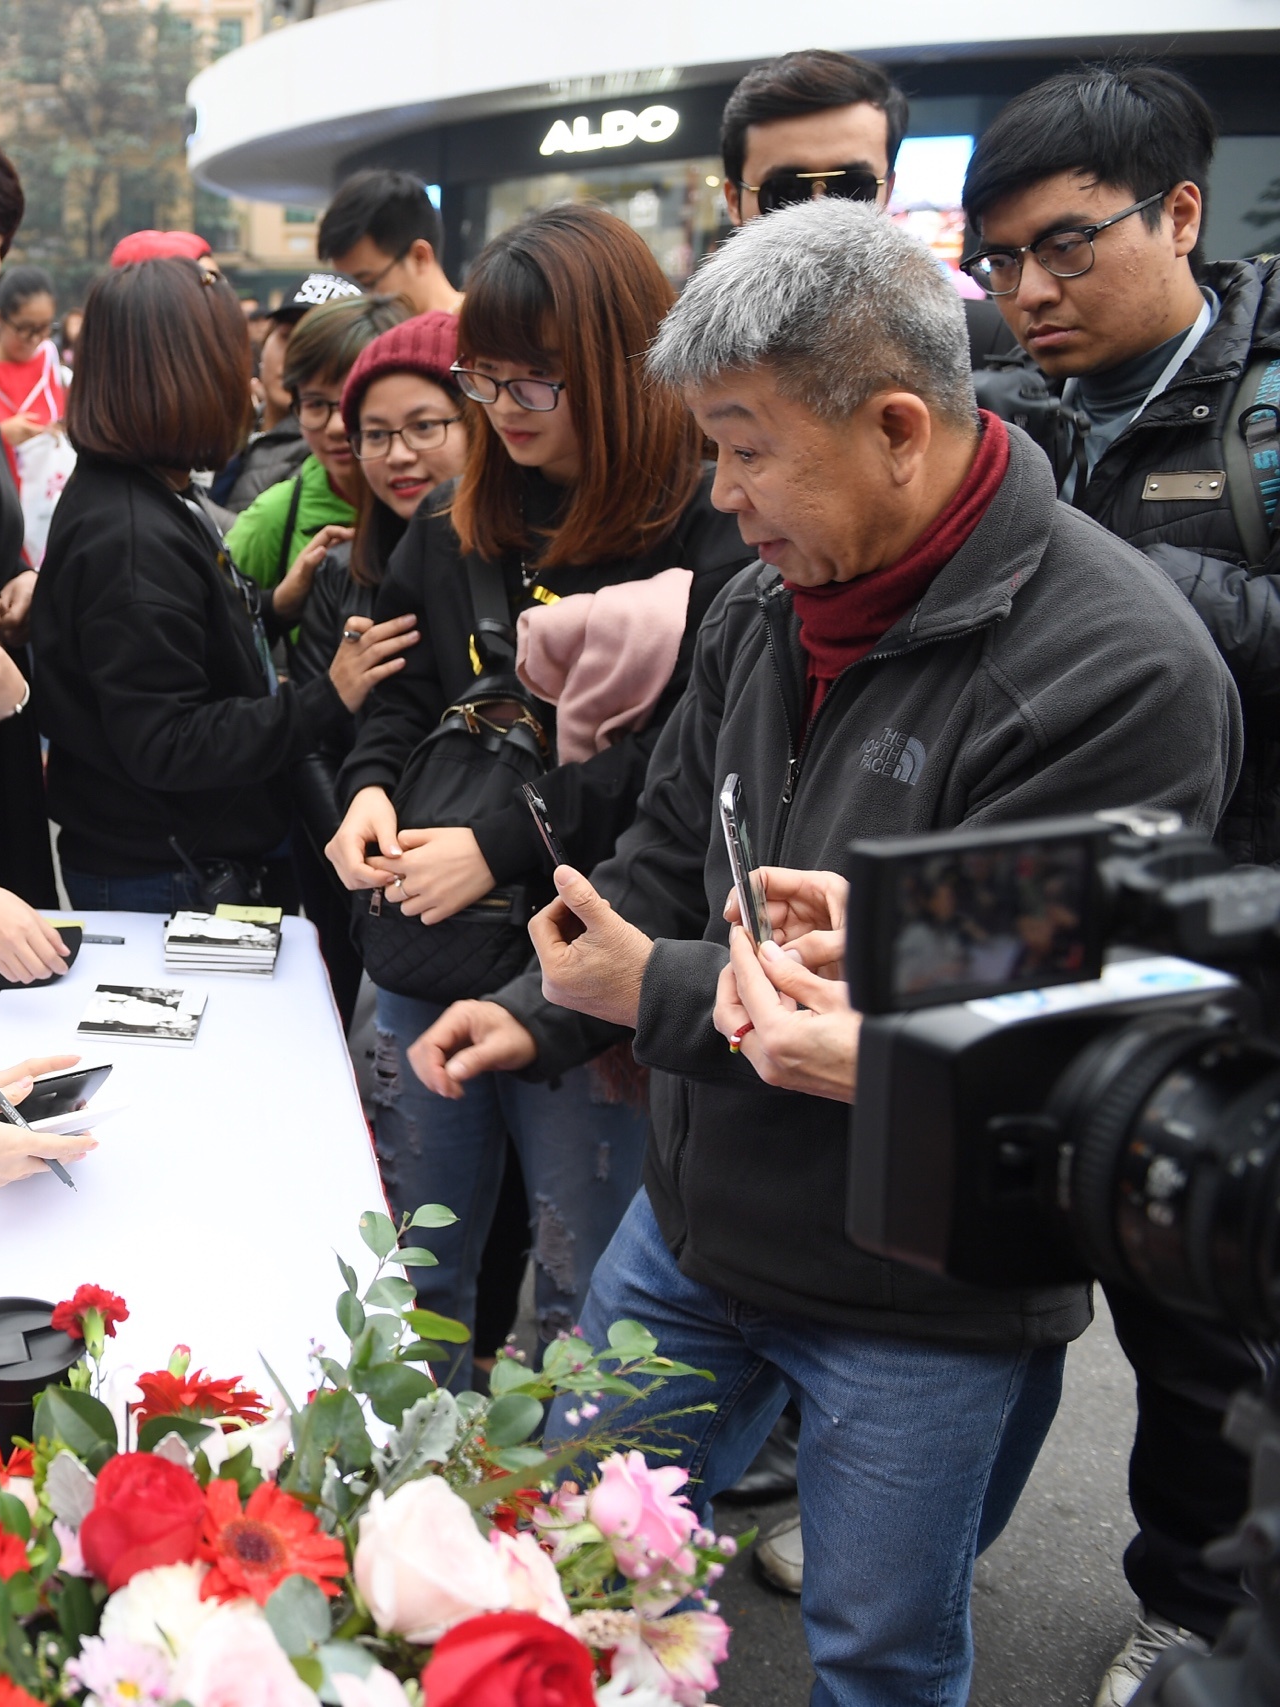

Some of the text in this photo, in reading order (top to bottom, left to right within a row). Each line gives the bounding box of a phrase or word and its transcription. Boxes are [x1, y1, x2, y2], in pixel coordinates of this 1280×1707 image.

[539, 105, 680, 156] ALDO
[880, 727, 908, 748] THE
[860, 754, 896, 777] FACE
